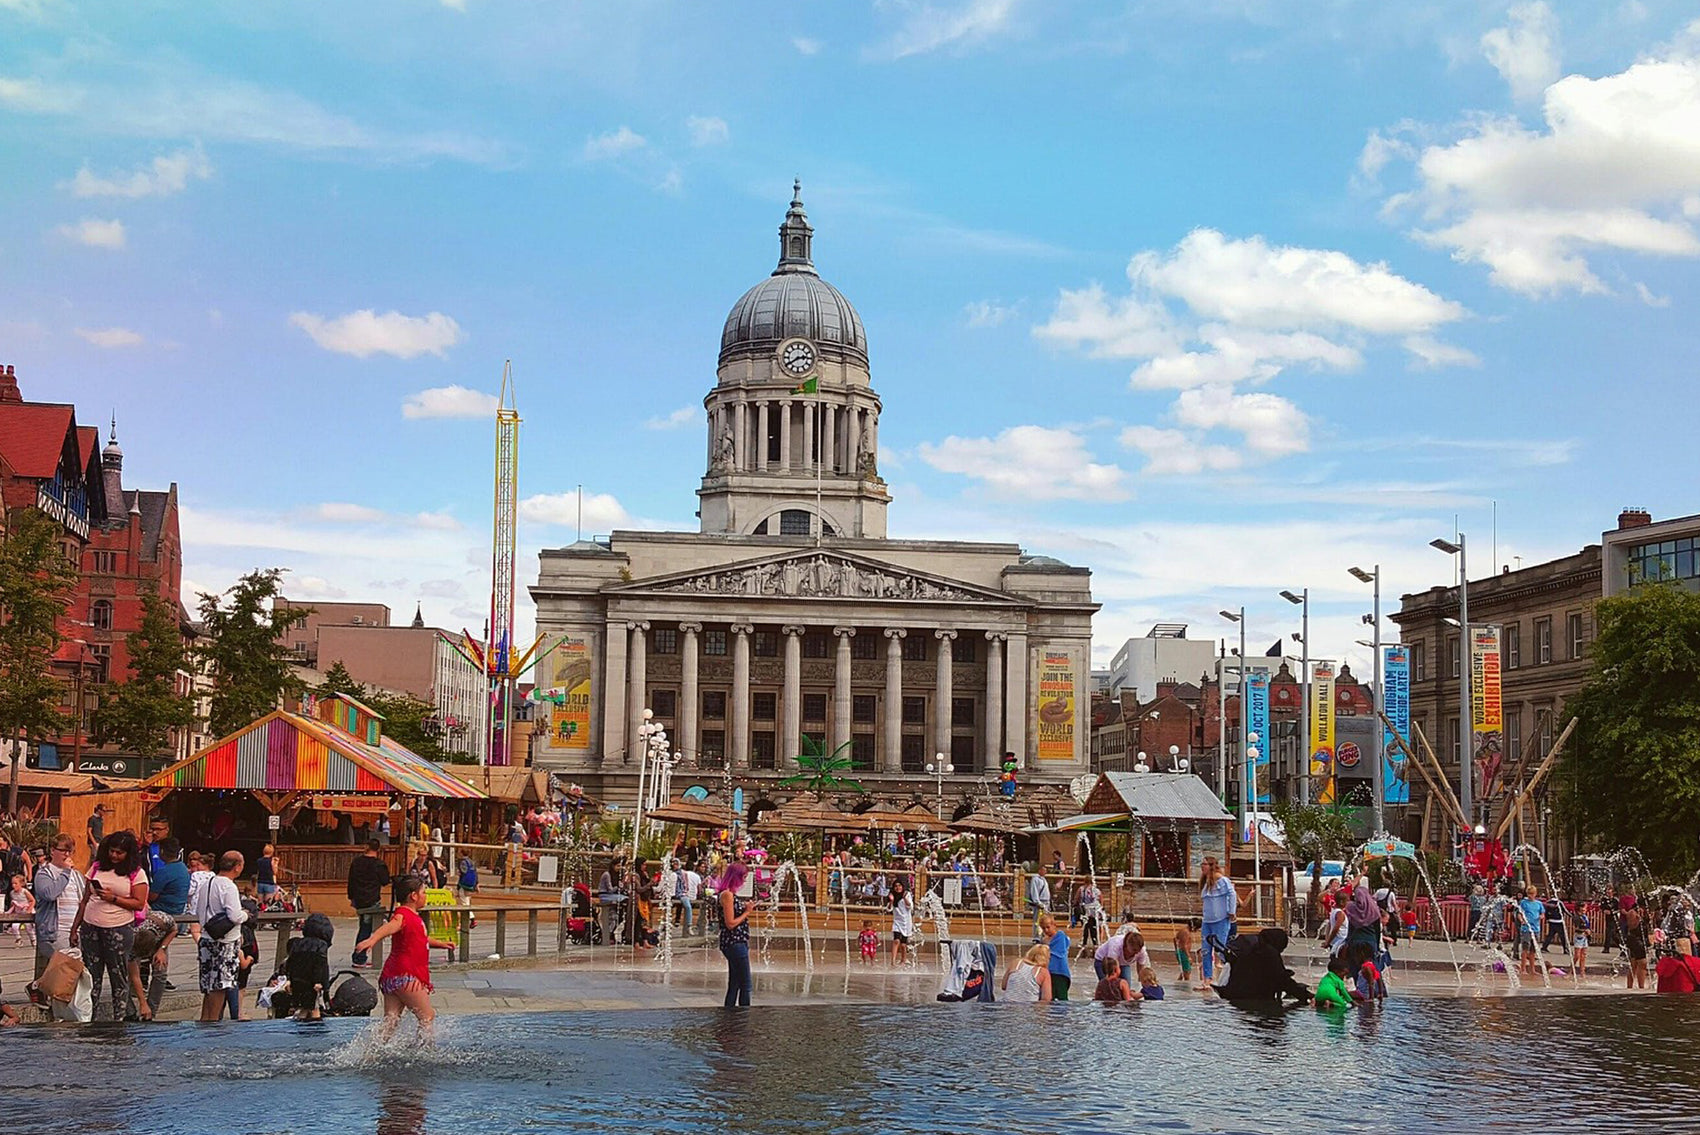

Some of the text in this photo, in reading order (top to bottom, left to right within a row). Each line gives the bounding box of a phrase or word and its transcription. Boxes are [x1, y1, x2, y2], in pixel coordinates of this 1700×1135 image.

[1041, 673, 1073, 681] JOIN THE
[1318, 684, 1328, 702] HALL
[1474, 652, 1484, 725] WORLD EXCLUSIVE
[1484, 653, 1501, 725] EXHIBITION
[1253, 693, 1263, 711] 2017
[1397, 670, 1408, 734] LAKESIDE ARTS
[1253, 712, 1263, 728] OCT
[1318, 703, 1328, 742] WOLLATON
[1040, 724, 1073, 734] WORLD
[1338, 746, 1358, 757] BURGER
[1340, 751, 1359, 762] KING
[79, 762, 109, 771] Clarks
